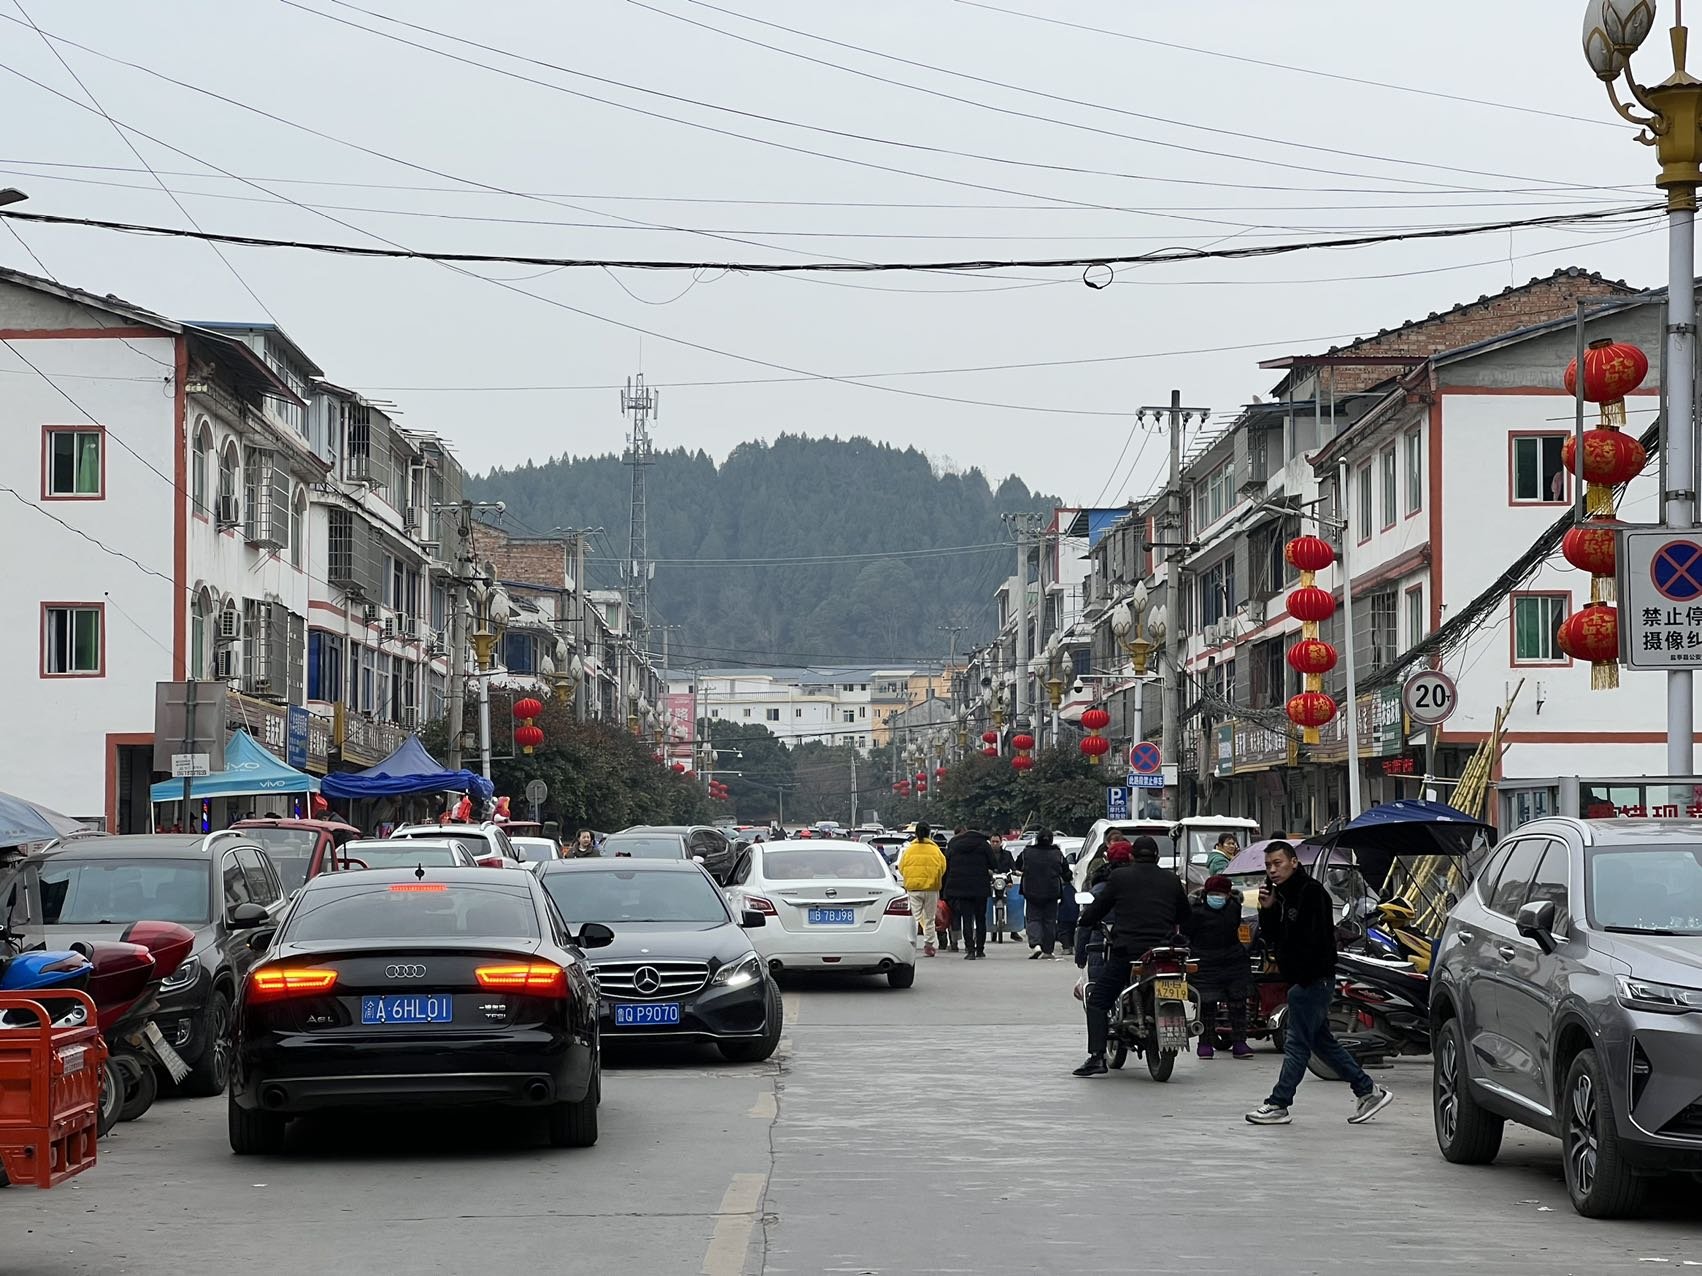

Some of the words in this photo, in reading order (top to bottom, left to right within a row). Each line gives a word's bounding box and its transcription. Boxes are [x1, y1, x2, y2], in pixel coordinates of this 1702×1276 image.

[1641, 606, 1702, 627] 禁止停
[1642, 630, 1702, 651] 摄像纠
[224, 762, 260, 772] ivo
[259, 779, 286, 788] vivo
[1111, 788, 1122, 805] P
